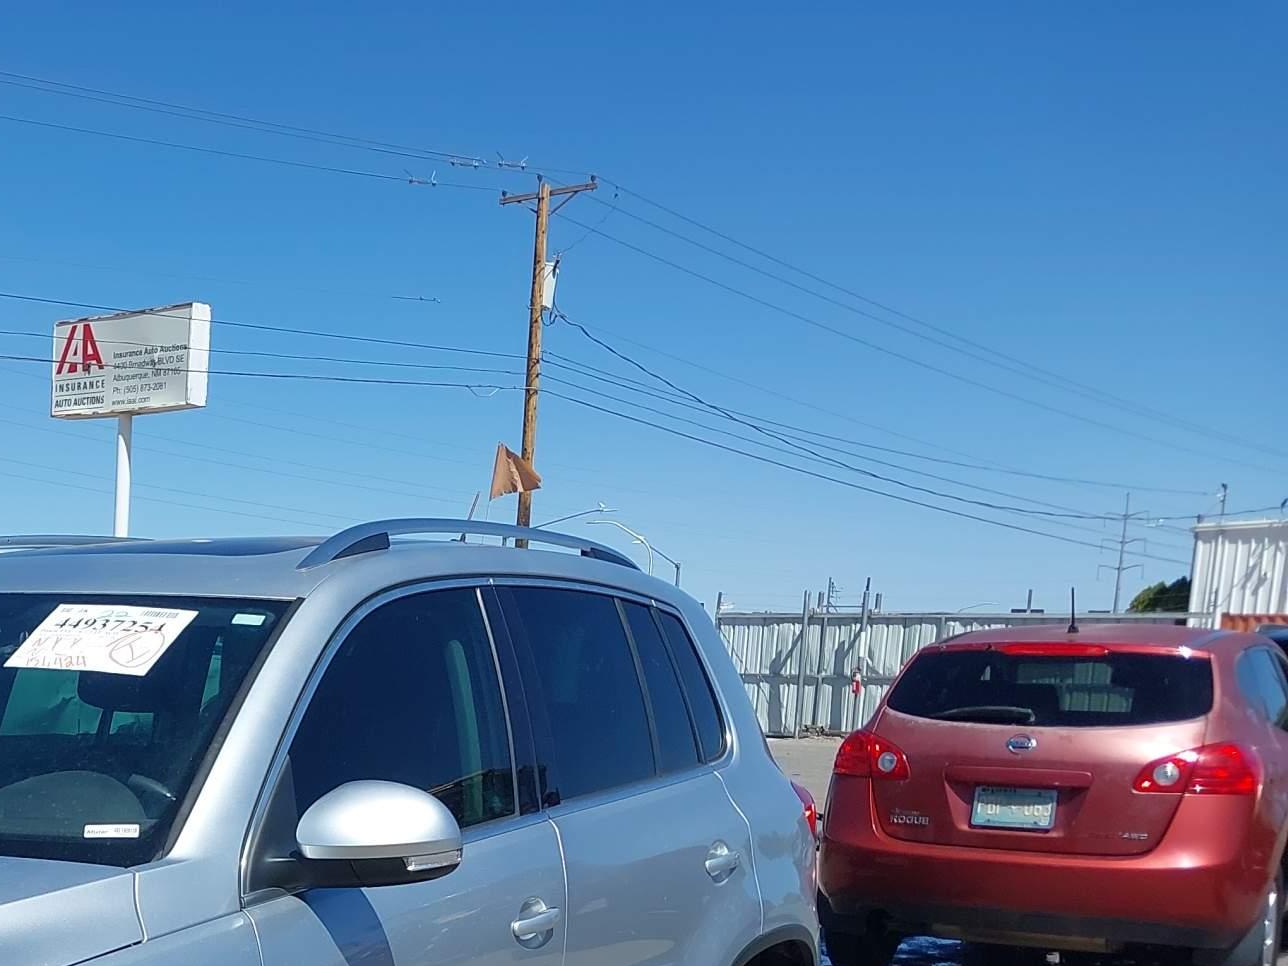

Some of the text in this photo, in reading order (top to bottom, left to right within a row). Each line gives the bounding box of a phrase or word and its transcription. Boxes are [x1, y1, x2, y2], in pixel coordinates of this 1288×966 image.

[113, 350, 143, 359] Insurance
[144, 346, 159, 355] Auto
[157, 355, 175, 366] BLVD
[175, 353, 185, 363] SE
[55, 379, 106, 393] INSURANCE
[54, 395, 106, 409] AUTO AUCTIONS
[54, 616, 167, 634] 44937254
[889, 815, 929, 825] ROGUE
